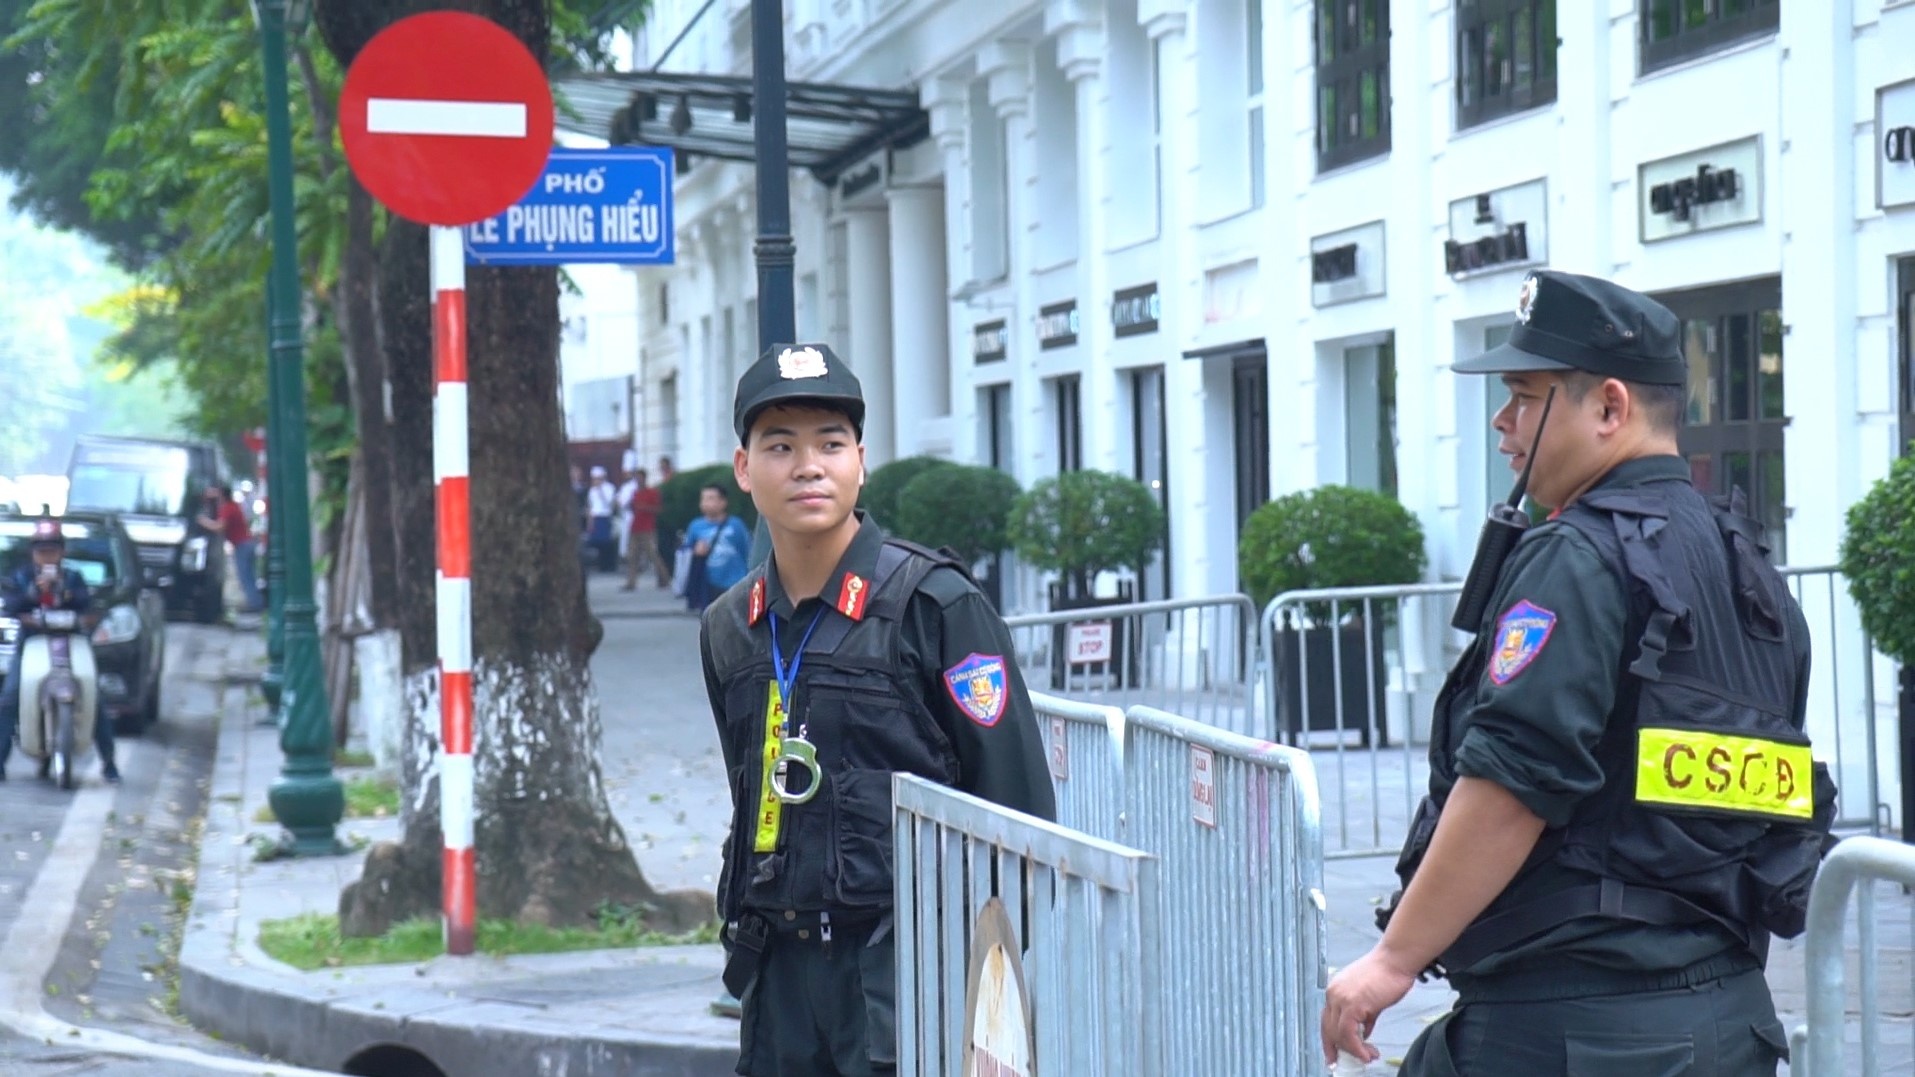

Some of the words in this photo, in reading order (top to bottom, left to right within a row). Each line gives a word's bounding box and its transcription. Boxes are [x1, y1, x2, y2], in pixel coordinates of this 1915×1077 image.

[545, 166, 606, 194] PHỐ
[507, 205, 594, 252] PHỤNG
[601, 189, 659, 243] HIỂU
